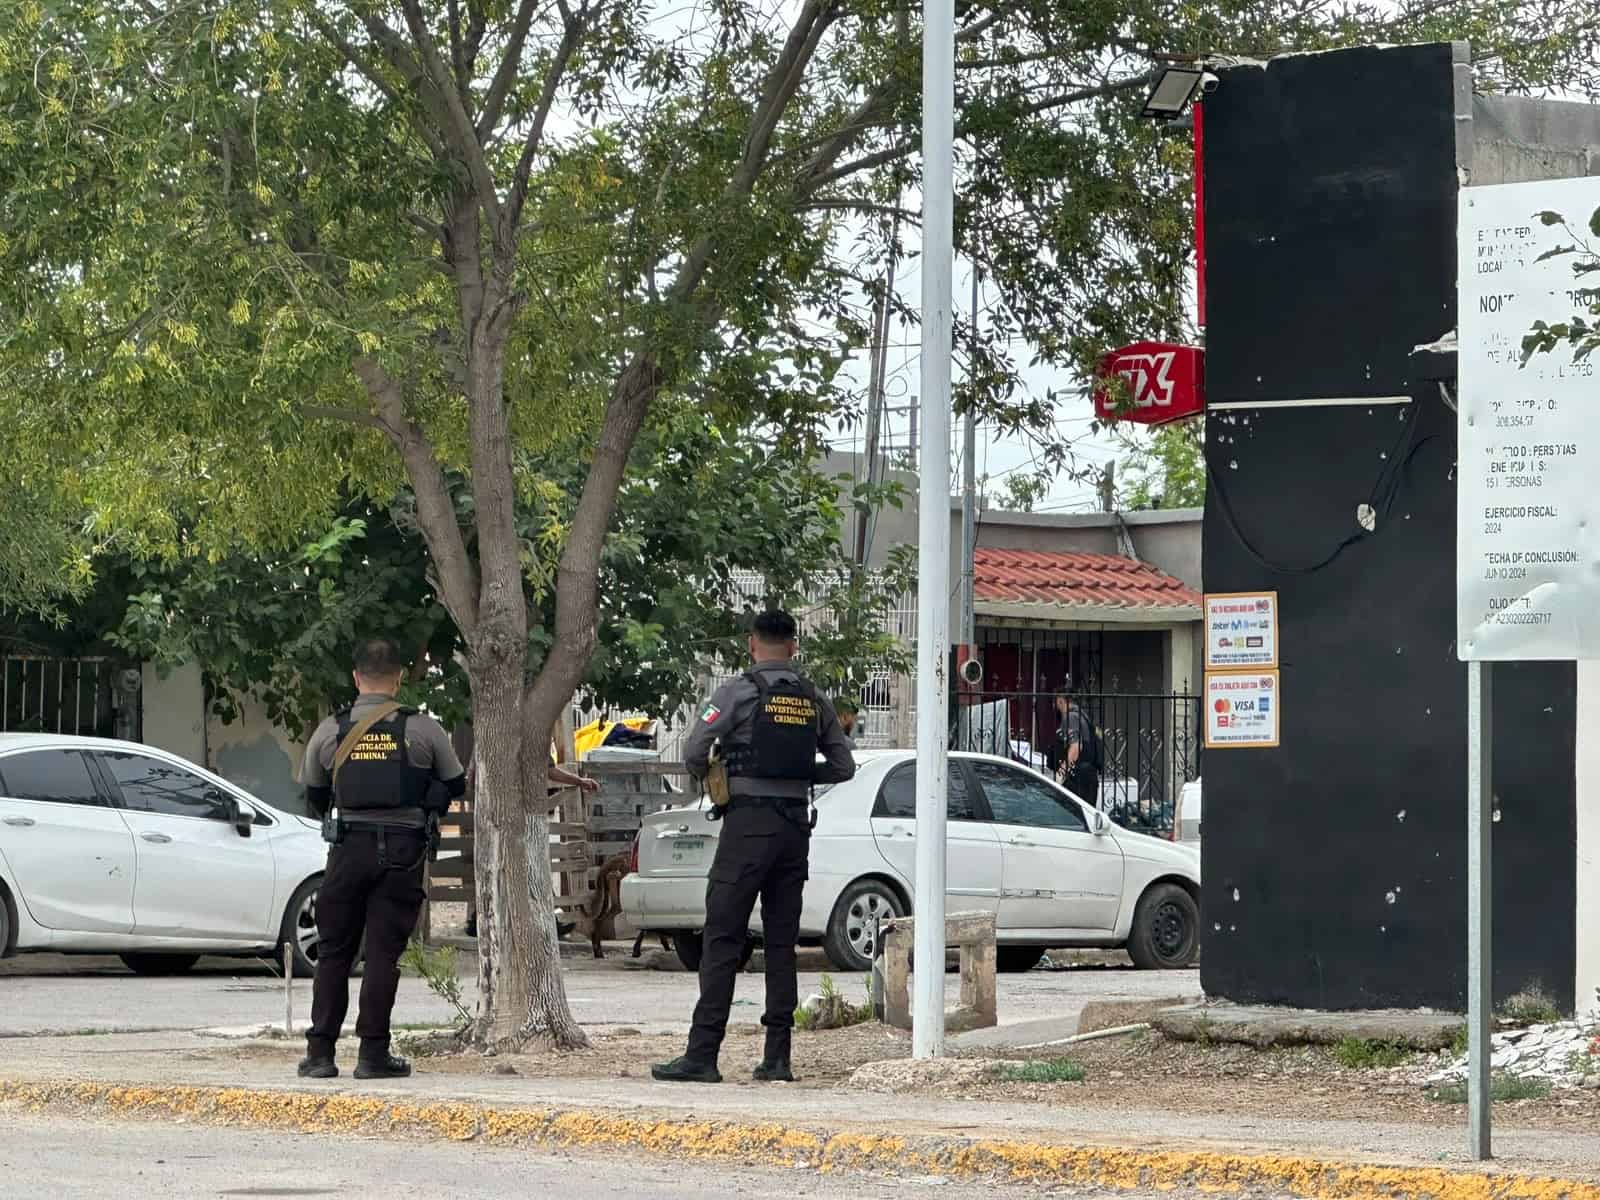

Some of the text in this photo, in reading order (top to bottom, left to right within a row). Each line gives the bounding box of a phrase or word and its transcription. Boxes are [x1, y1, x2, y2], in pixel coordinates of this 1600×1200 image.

[1485, 505, 1558, 519] EJERCICIO FISCAL:
[1485, 522, 1502, 534] 2024
[1485, 551, 1511, 564] ECHA
[1509, 567, 1527, 579] 2024
[1234, 700, 1255, 711] VISA
[774, 714, 808, 725] CRIMINAL
[380, 733, 392, 741] DE
[350, 751, 388, 761] CRIMINAL
